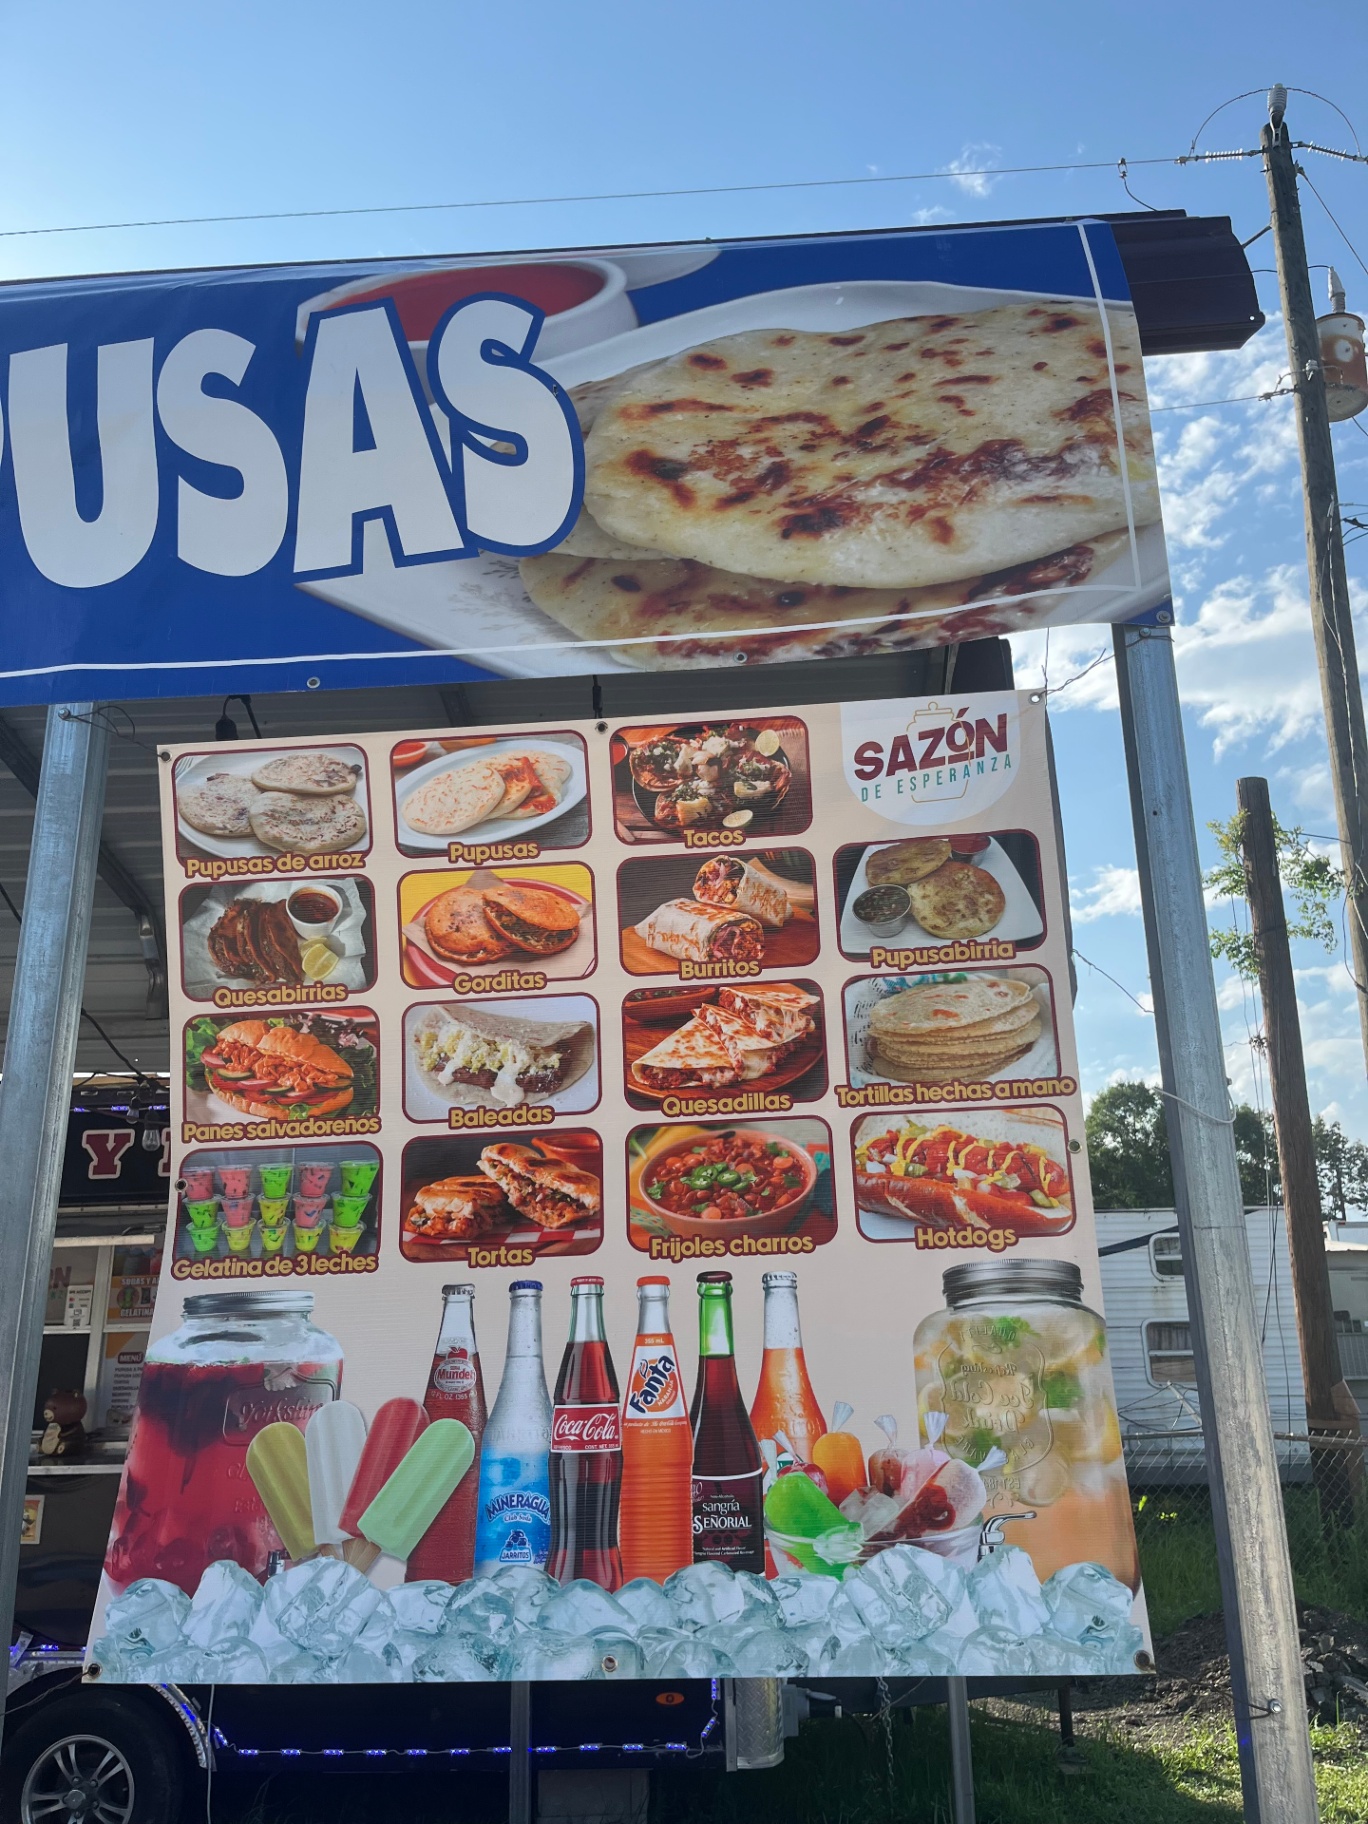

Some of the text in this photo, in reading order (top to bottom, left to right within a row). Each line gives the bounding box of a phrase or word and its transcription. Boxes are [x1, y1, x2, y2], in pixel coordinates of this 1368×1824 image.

[0, 298, 580, 589] USAS
[854, 707, 1008, 781] SAZÓN
[861, 753, 1012, 802] DE ESPERANZA
[684, 828, 744, 847] Tacos
[187, 851, 363, 878] Pupusas de arroz
[450, 843, 539, 864] Pupusas
[872, 940, 1014, 967] Pupusabirria
[681, 958, 760, 978] Burritos
[454, 972, 545, 993] Gorditas
[214, 985, 347, 1008] Quesabirrias
[663, 1093, 791, 1115] Quesadillas
[838, 1078, 1075, 1106] Tortillas hechas a mano
[183, 1115, 380, 1142] Panes salvadoreños
[450, 1106, 553, 1128] Baleadas
[651, 1234, 813, 1261] Frijoles charros
[917, 1226, 1016, 1251] Hotdogs
[174, 1252, 376, 1279] Gelatina de 3 leches
[468, 1247, 533, 1266] Tortas
[629, 1355, 675, 1414] Fanta
[554, 1413, 617, 1441] Coca-Cola
[702, 1498, 740, 1515] sangría
[692, 1513, 752, 1534] SEÑORIAL
